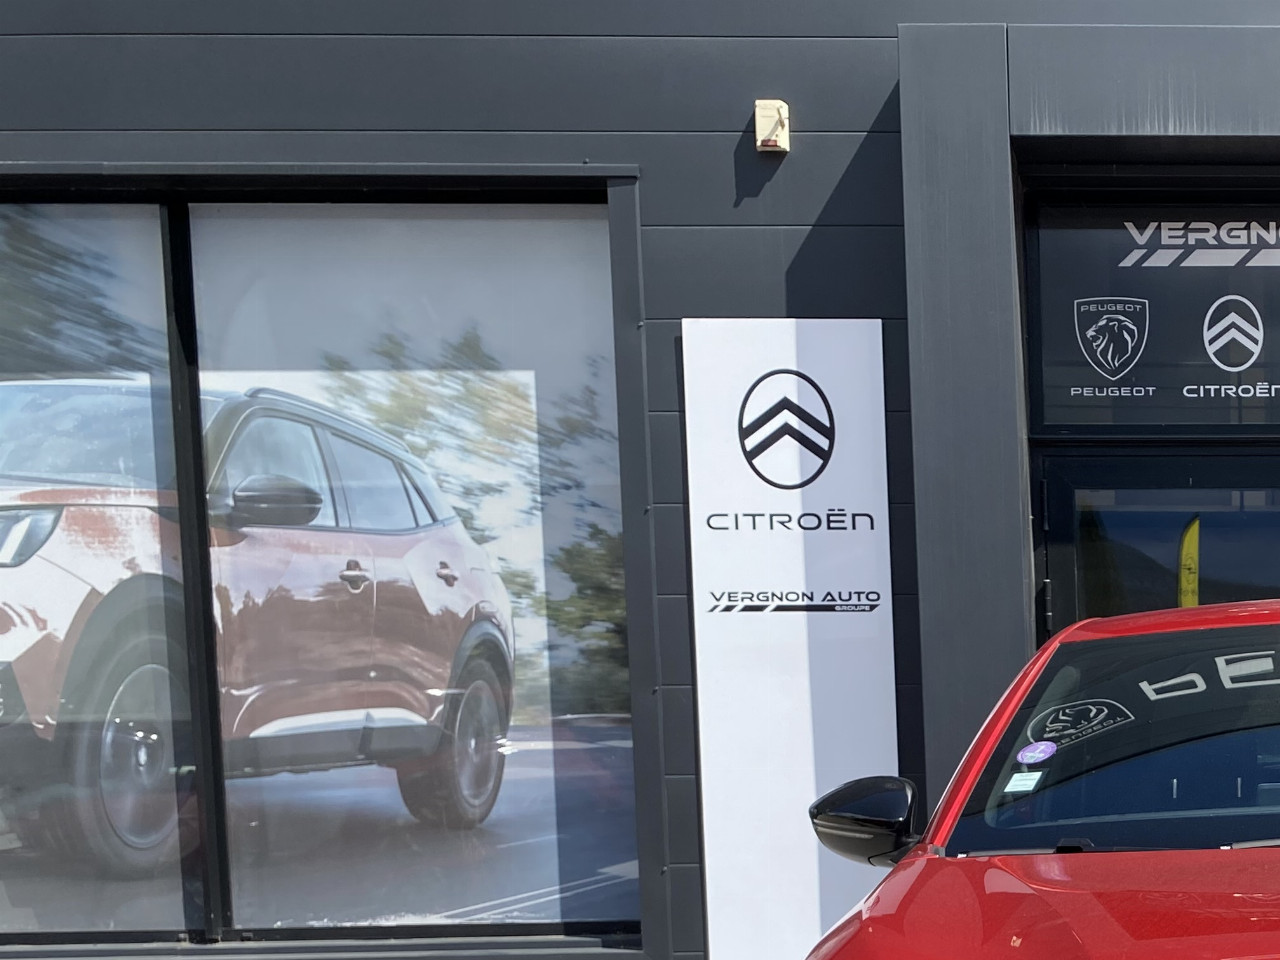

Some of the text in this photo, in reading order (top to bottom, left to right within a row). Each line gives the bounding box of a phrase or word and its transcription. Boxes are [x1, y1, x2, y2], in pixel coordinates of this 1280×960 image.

[1080, 302, 1142, 314] PEUGEOT
[1070, 385, 1156, 397] PEUGEOT
[709, 590, 881, 603] VERGNON AUTO
